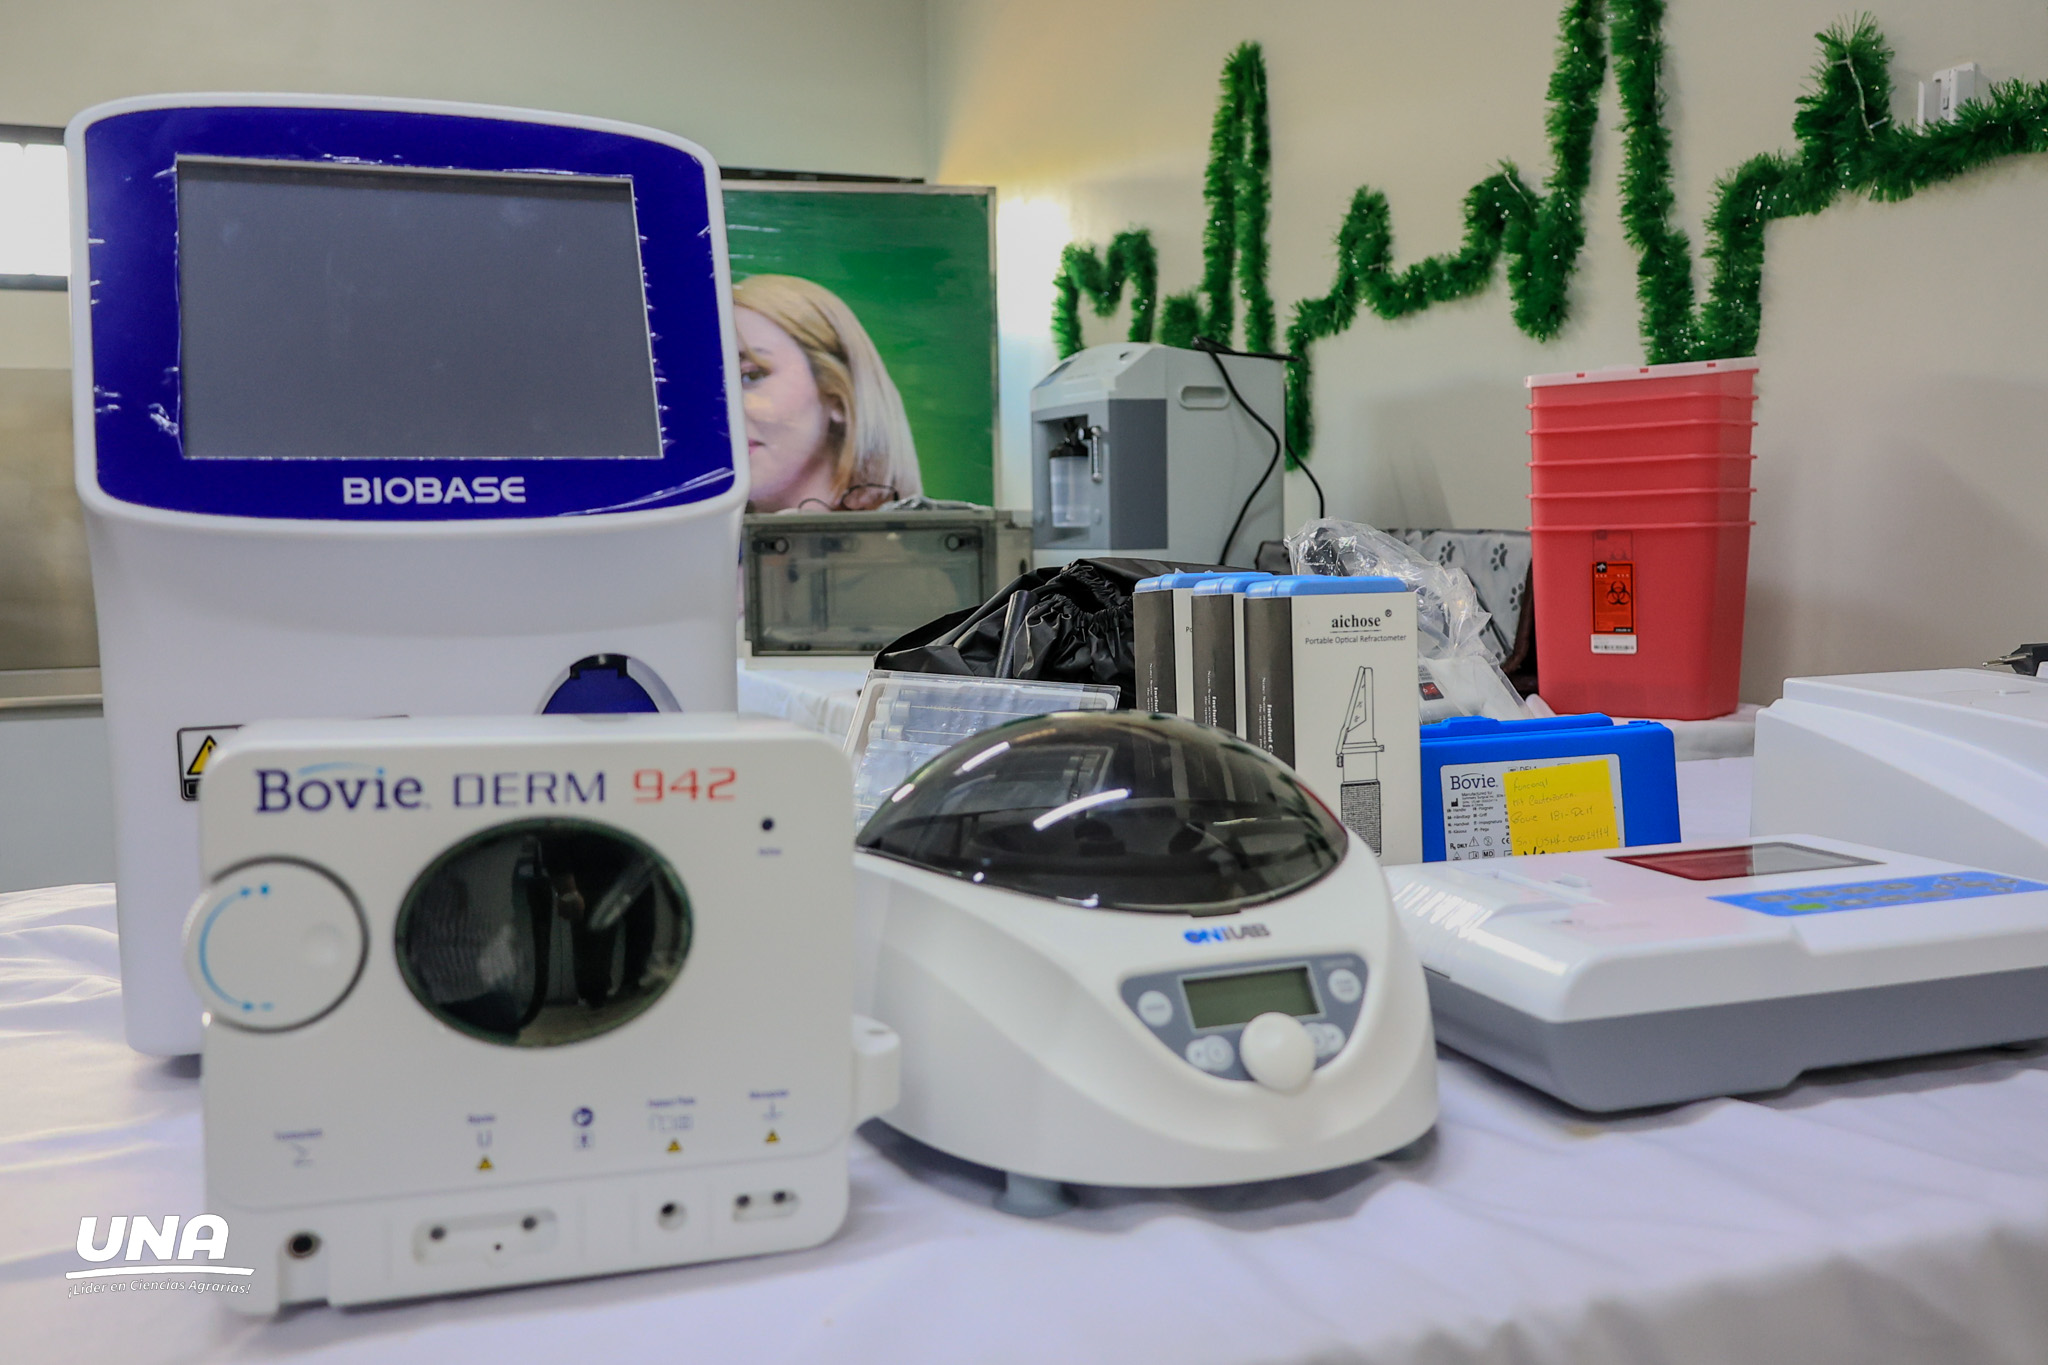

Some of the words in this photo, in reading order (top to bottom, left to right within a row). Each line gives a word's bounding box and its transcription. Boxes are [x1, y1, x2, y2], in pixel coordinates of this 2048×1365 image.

[342, 476, 527, 505] BIOBASE
[1331, 614, 1381, 628] aichose
[1305, 637, 1333, 645] Portable
[1335, 636, 1358, 645] Optical
[1360, 634, 1407, 643] Refractometer
[254, 766, 424, 813] Bovie
[453, 771, 605, 808] DERM
[633, 768, 737, 804] 942
[1450, 774, 1496, 790] Bovie
